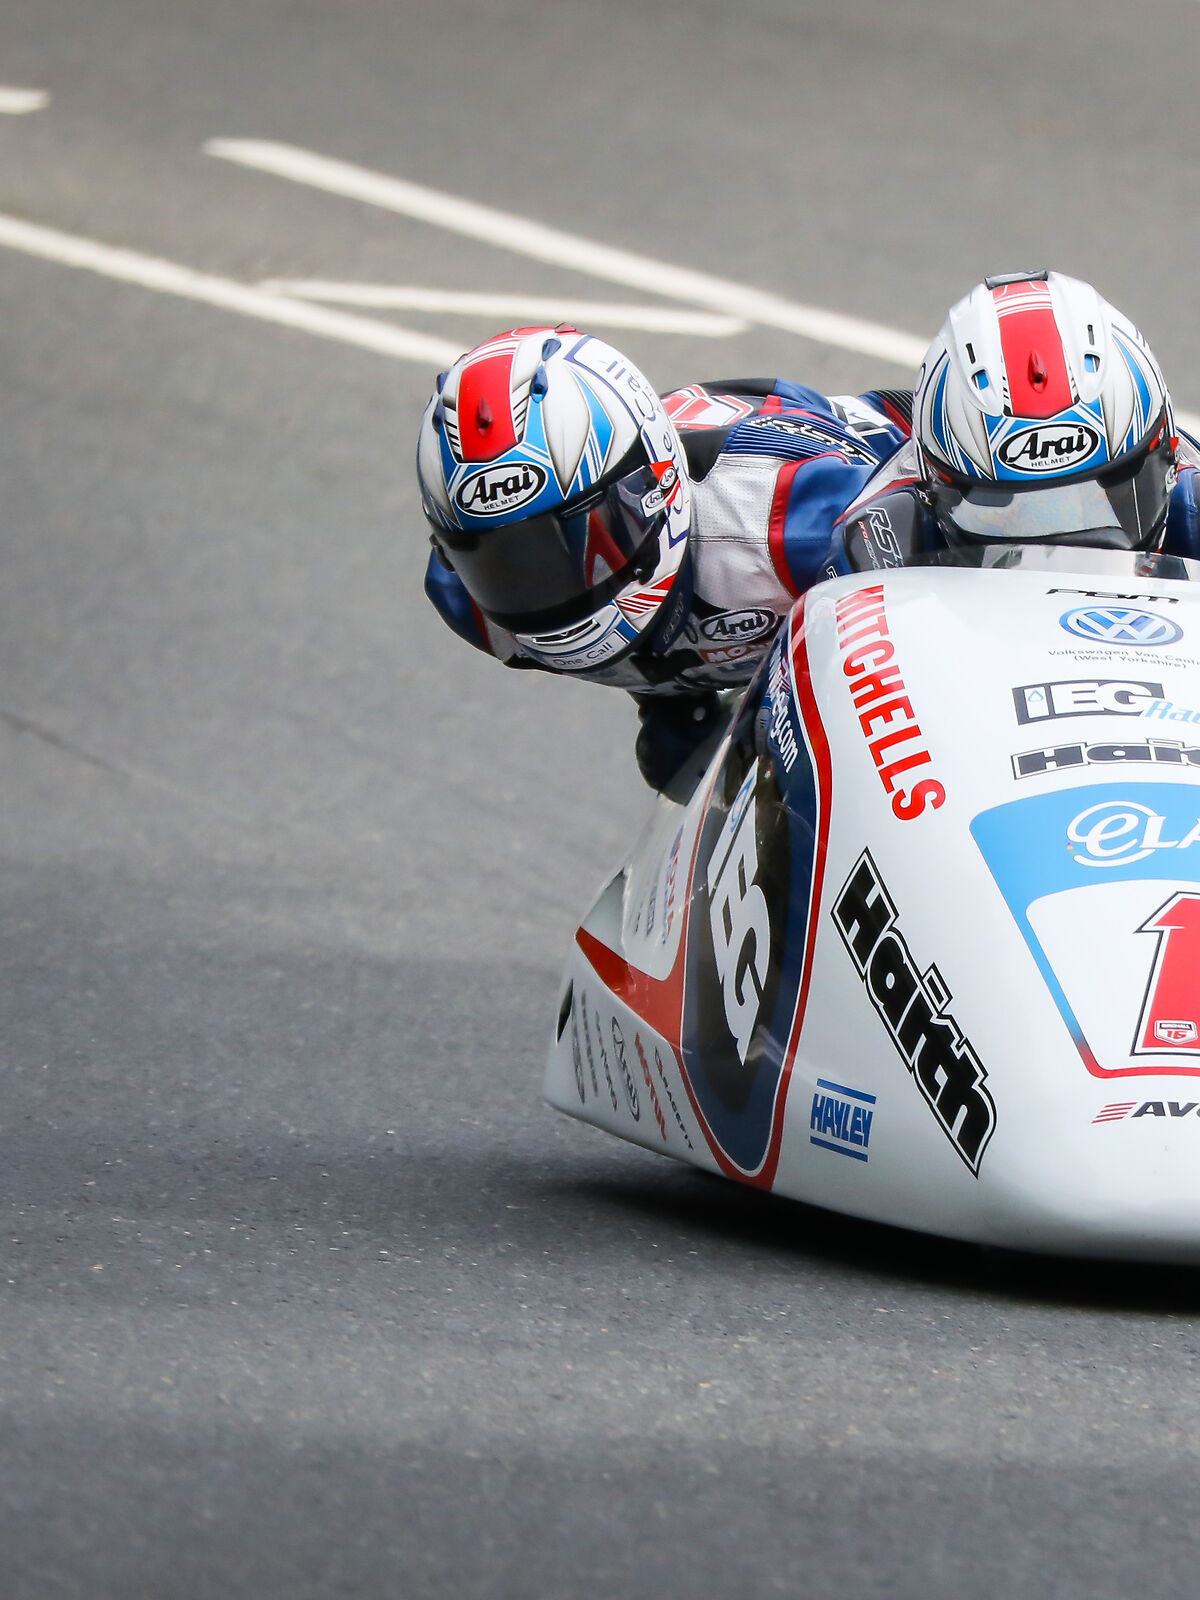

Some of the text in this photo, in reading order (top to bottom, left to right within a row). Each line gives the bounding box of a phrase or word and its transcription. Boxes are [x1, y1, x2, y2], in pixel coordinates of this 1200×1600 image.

[1005, 426, 1088, 463] Arai
[1031, 456, 1071, 468] HELMET
[462, 465, 535, 509] Arai
[483, 495, 519, 511] HELMET
[707, 610, 766, 638] Arai
[553, 657, 584, 667] One
[586, 641, 613, 660] Call
[1048, 649, 1130, 657] Volkswagen
[1135, 651, 1159, 659] Van
[835, 584, 947, 821] MITCHELLS
[1021, 681, 1158, 720] IEG
[830, 846, 998, 1181] Haith
[810, 1093, 874, 1148] HAYLEY
